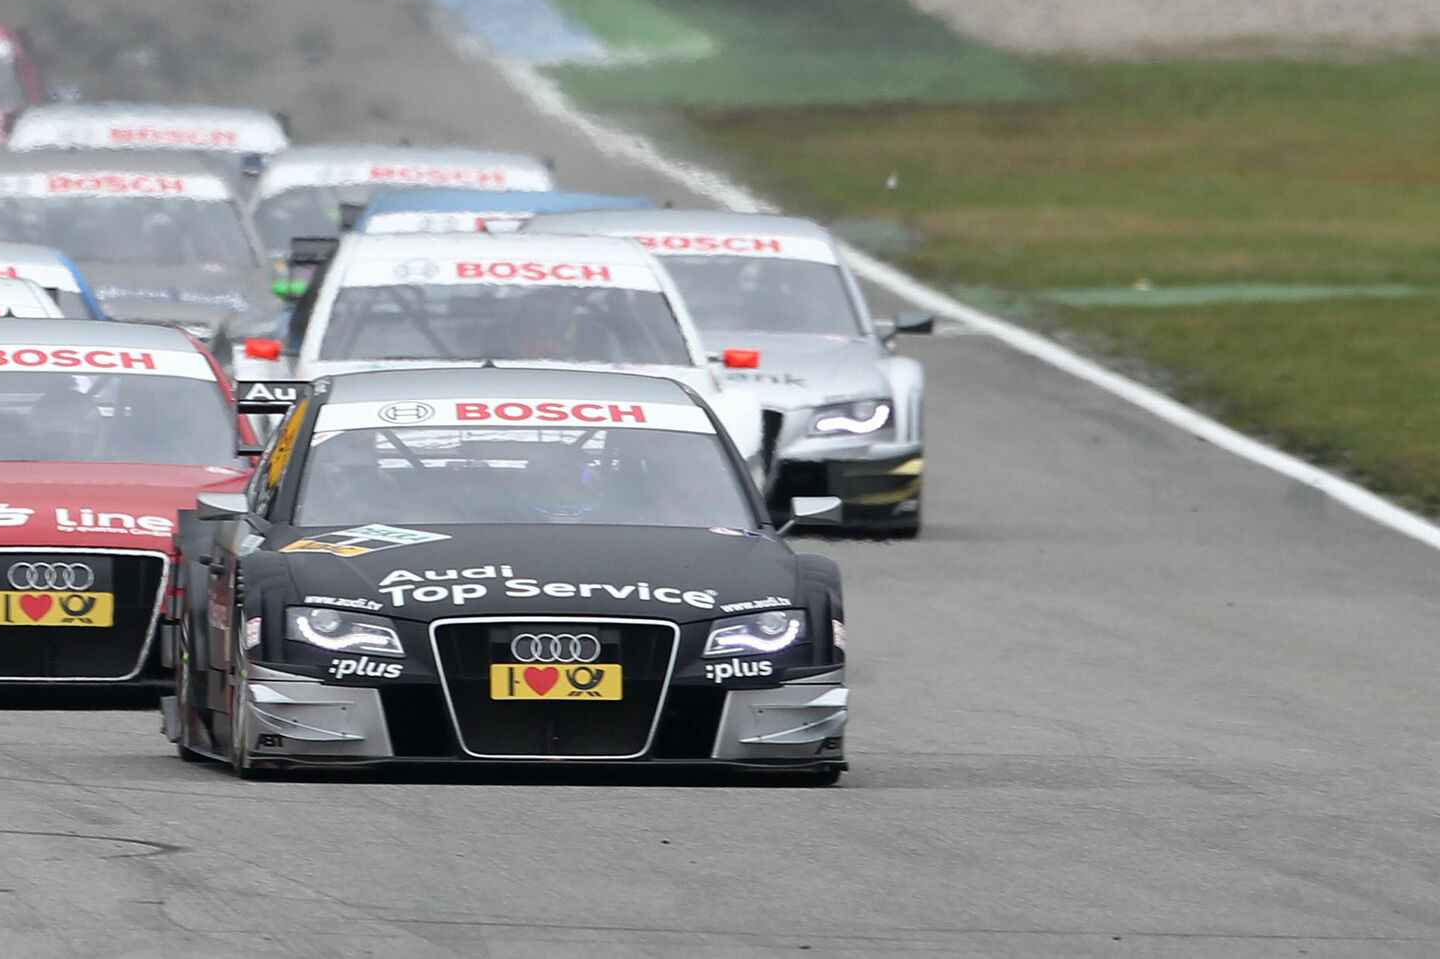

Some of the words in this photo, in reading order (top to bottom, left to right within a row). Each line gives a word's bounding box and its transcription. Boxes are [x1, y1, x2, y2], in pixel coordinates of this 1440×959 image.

[48, 175, 185, 194] BOSCH
[454, 262, 612, 282] BOSCH
[725, 371, 805, 388] ank
[244, 383, 298, 401] Au
[456, 402, 647, 425] BOSCH
[55, 508, 175, 532] line
[380, 565, 514, 585] Audi
[378, 583, 488, 607] Top
[504, 578, 715, 610] Service
